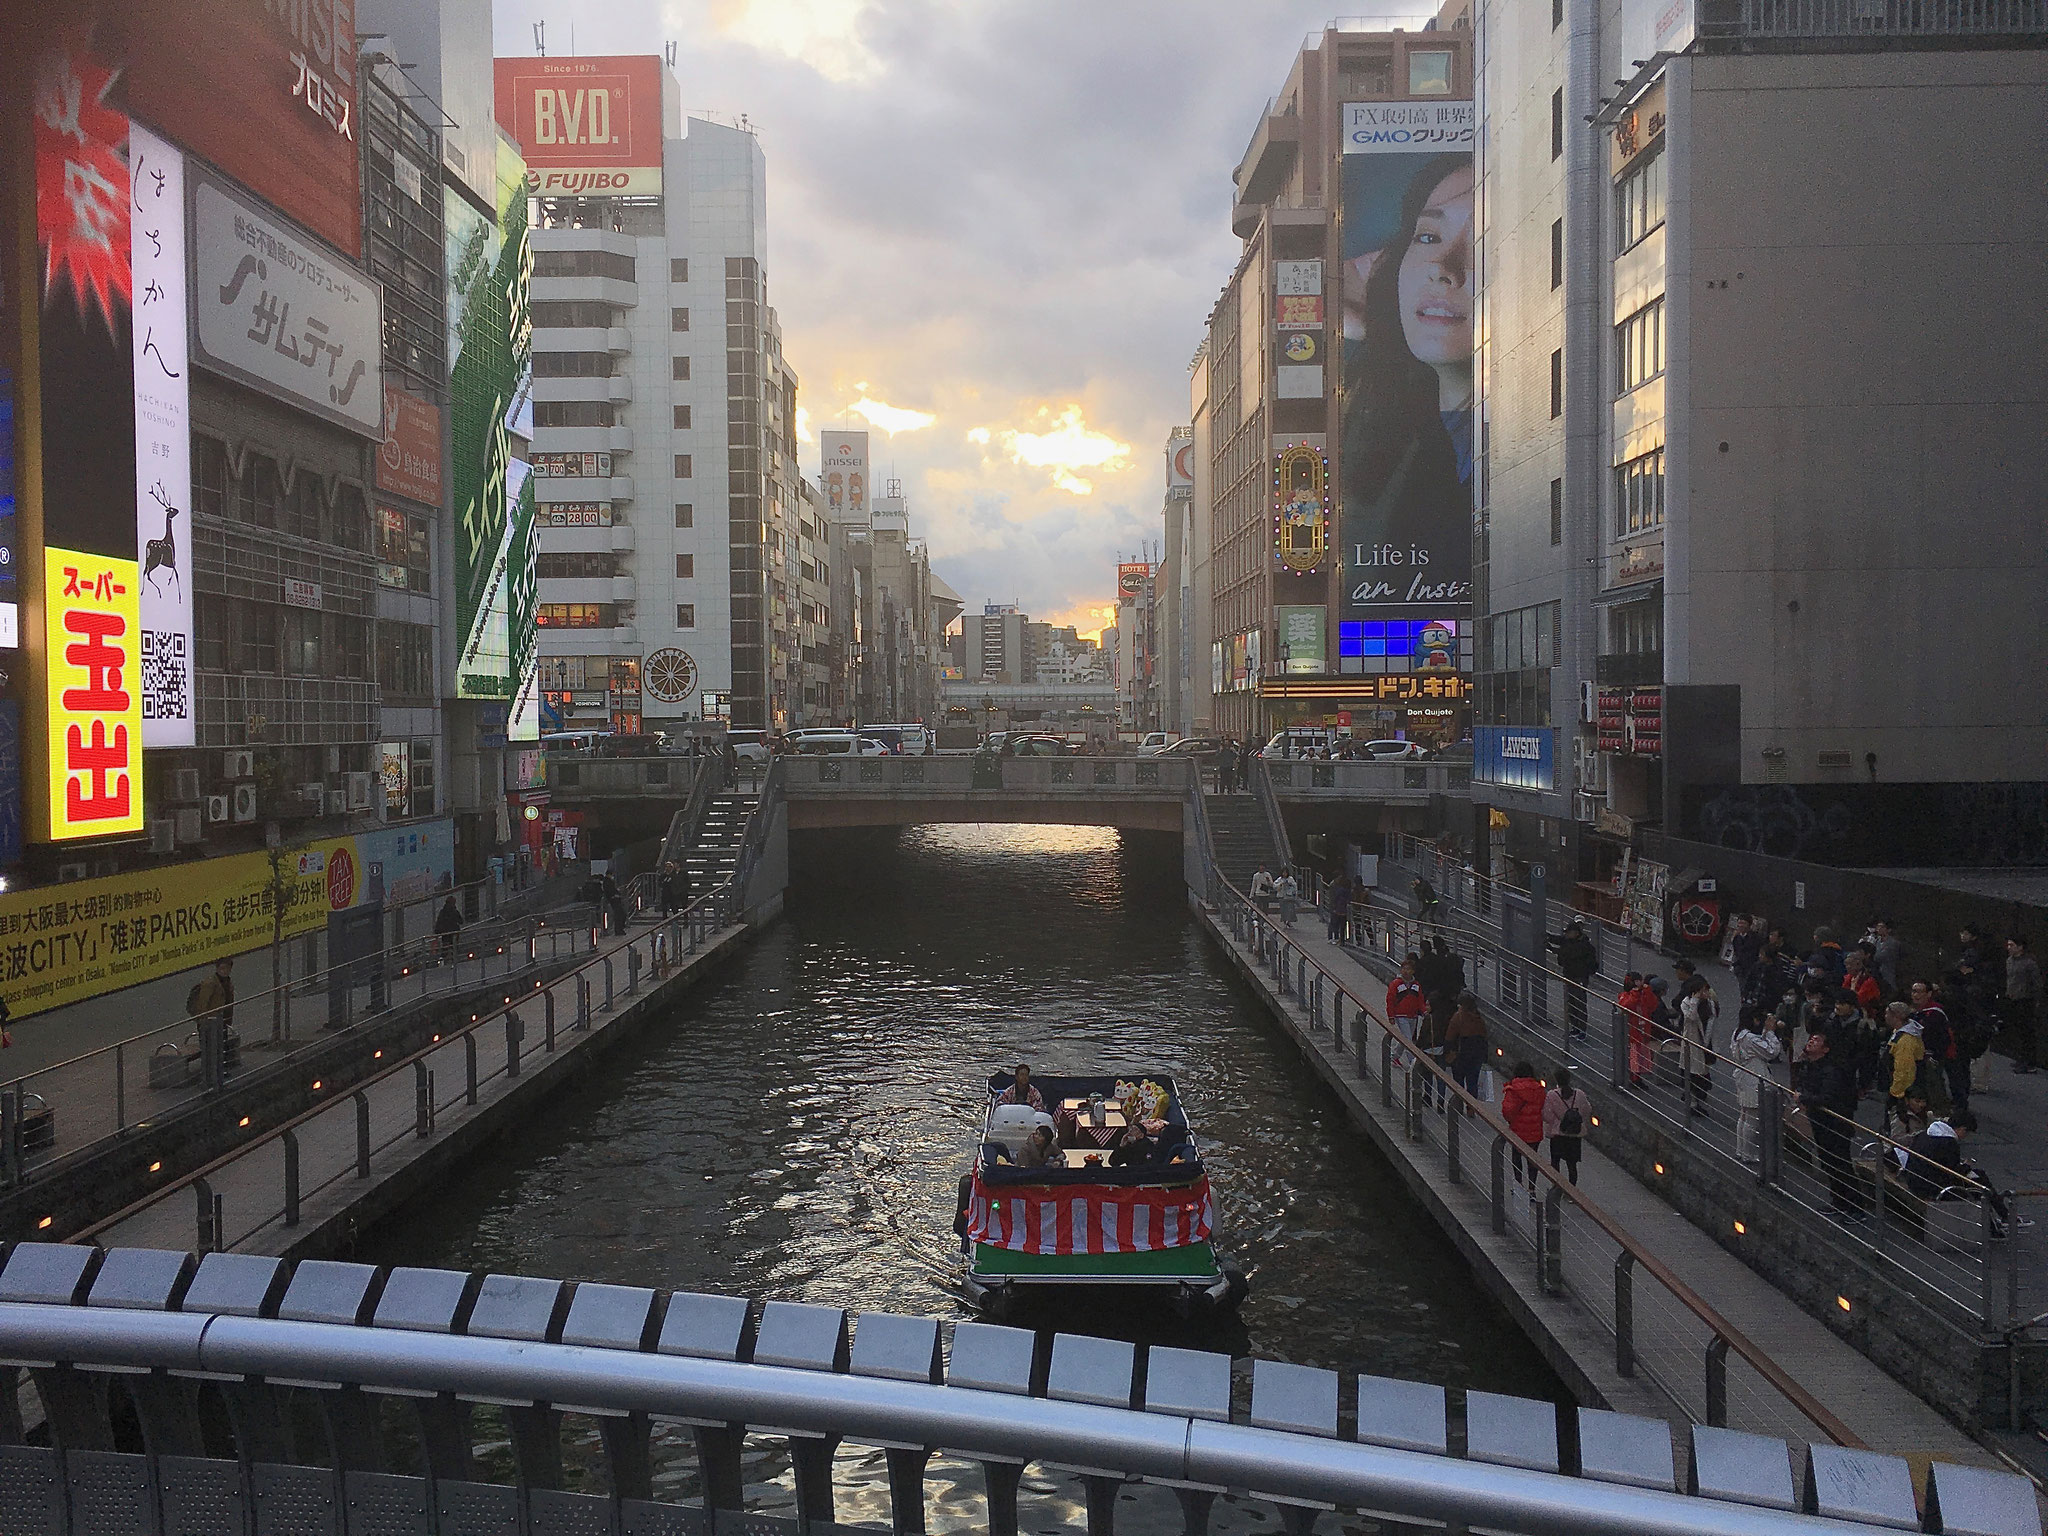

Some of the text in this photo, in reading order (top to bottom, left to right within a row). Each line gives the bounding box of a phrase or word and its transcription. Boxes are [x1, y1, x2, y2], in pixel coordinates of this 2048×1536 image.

[544, 65, 571, 73] Since
[289, 50, 353, 141] プロミス
[545, 172, 630, 194] FUJIBO
[134, 155, 180, 379] はちかん
[247, 290, 344, 378] サムティ
[138, 392, 179, 414] HACHIKAN
[142, 411, 176, 428] YOSHINO
[152, 441, 169, 458] 吉野
[828, 458, 862, 466] NISSEI
[1354, 543, 1430, 566] Life is
[63, 567, 126, 602] スーパー
[1351, 581, 1396, 600] an
[1288, 613, 1317, 642] 薬
[62, 609, 130, 824] 玉出
[1425, 708, 1454, 717] Quijote
[1501, 736, 1540, 760] LAWSON
[331, 853, 350, 882] TAX
[23, 982, 54, 999] shopping
[56, 975, 76, 990] center
[78, 972, 85, 985] in
